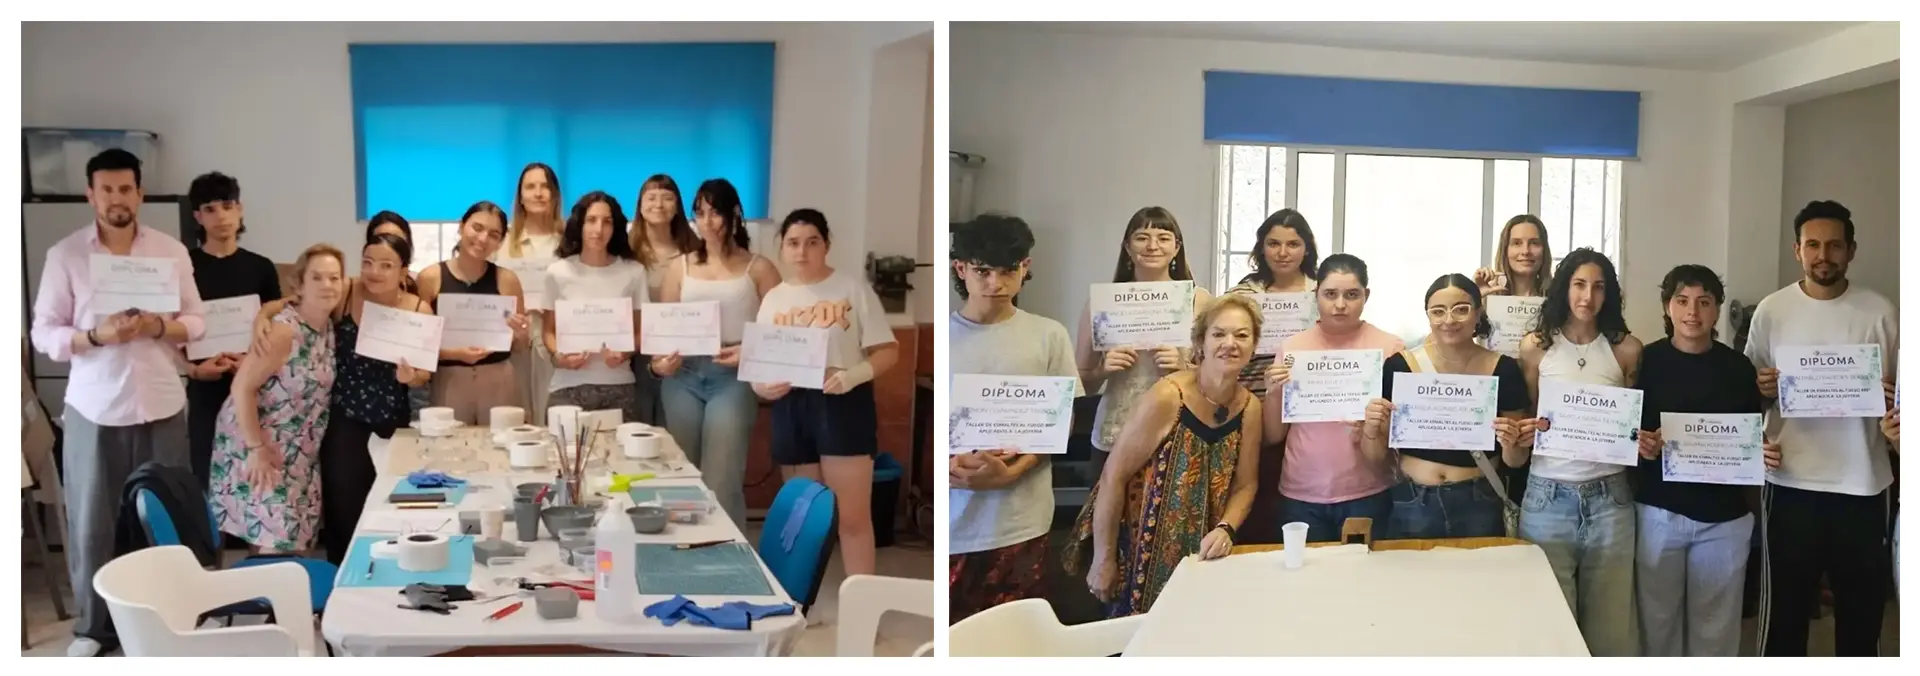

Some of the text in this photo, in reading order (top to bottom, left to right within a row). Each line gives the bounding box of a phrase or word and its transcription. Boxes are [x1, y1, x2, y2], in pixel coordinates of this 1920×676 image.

[1114, 292, 1168, 302] DIPLOMA
[1508, 306, 1542, 314] DIPLO
[1308, 362, 1359, 370] DIPLOMA
[1800, 357, 1855, 366] DIPLOMA
[982, 388, 1046, 398] DIPLOMA
[1417, 386, 1472, 396] DIPLOMA
[1563, 394, 1616, 408] DIPLOMA
[1685, 424, 1738, 433] DIPLOMA
